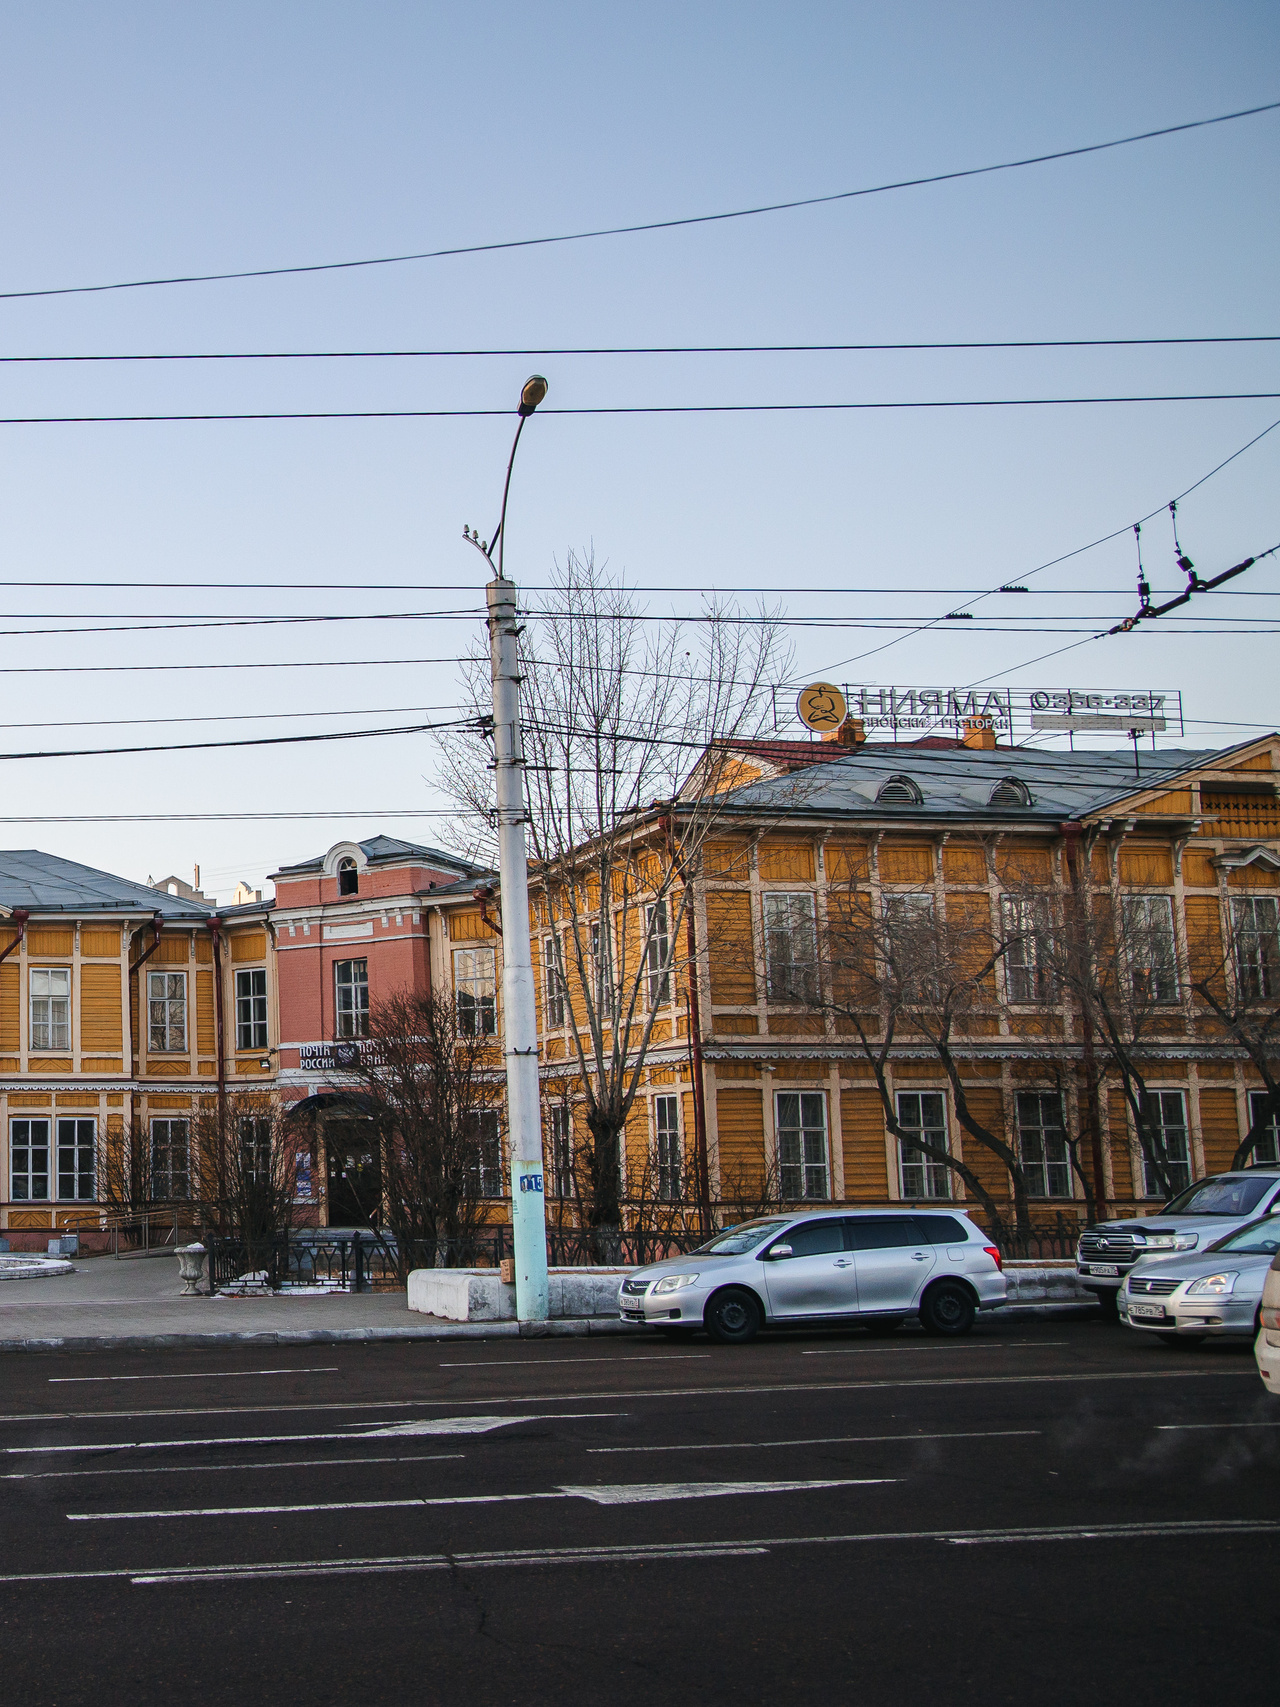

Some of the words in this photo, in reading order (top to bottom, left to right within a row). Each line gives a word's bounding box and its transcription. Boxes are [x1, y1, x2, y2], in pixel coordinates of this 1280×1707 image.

[860, 688, 1008, 715] НИЯМА
[942, 717, 1009, 729] РЕСТОРАН
[299, 1045, 331, 1058] ПОЧТА
[300, 1057, 336, 1070] РОССИИ
